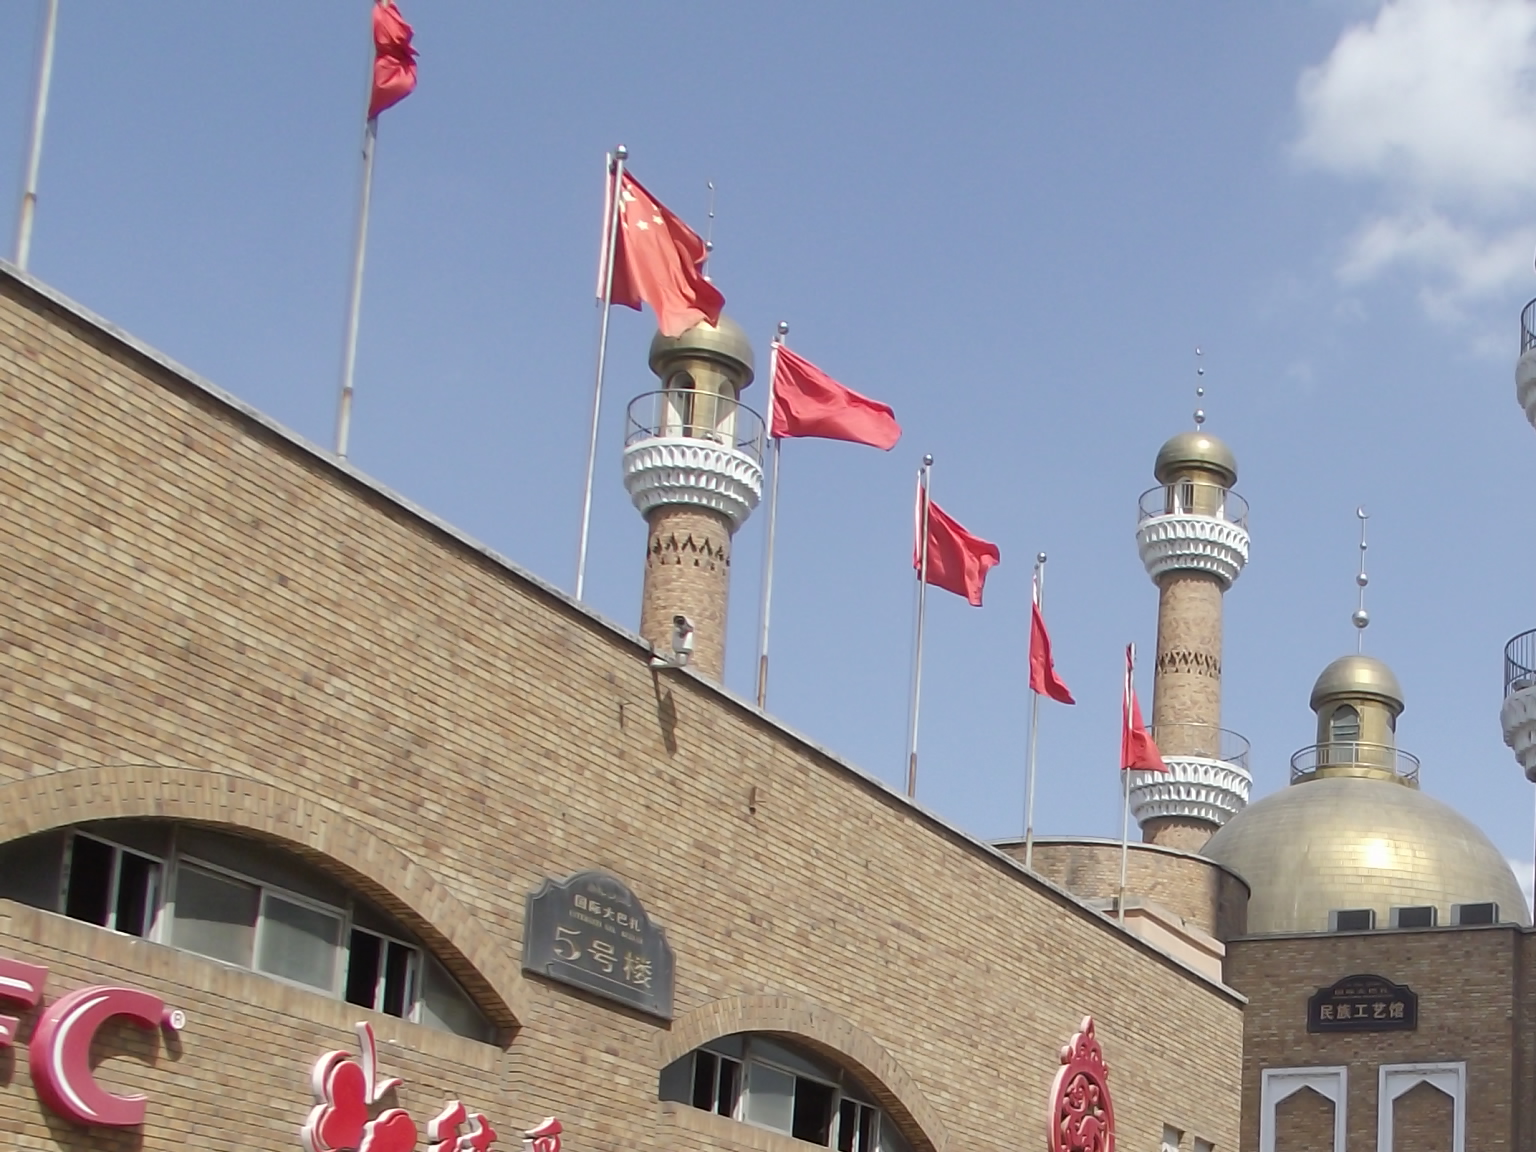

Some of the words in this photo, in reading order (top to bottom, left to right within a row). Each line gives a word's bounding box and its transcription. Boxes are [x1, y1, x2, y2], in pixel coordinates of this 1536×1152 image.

[573, 893, 642, 933] 国际大巴扎
[552, 925, 654, 989] 5号楼
[1319, 1001, 1406, 1021] 民族工艺馆
